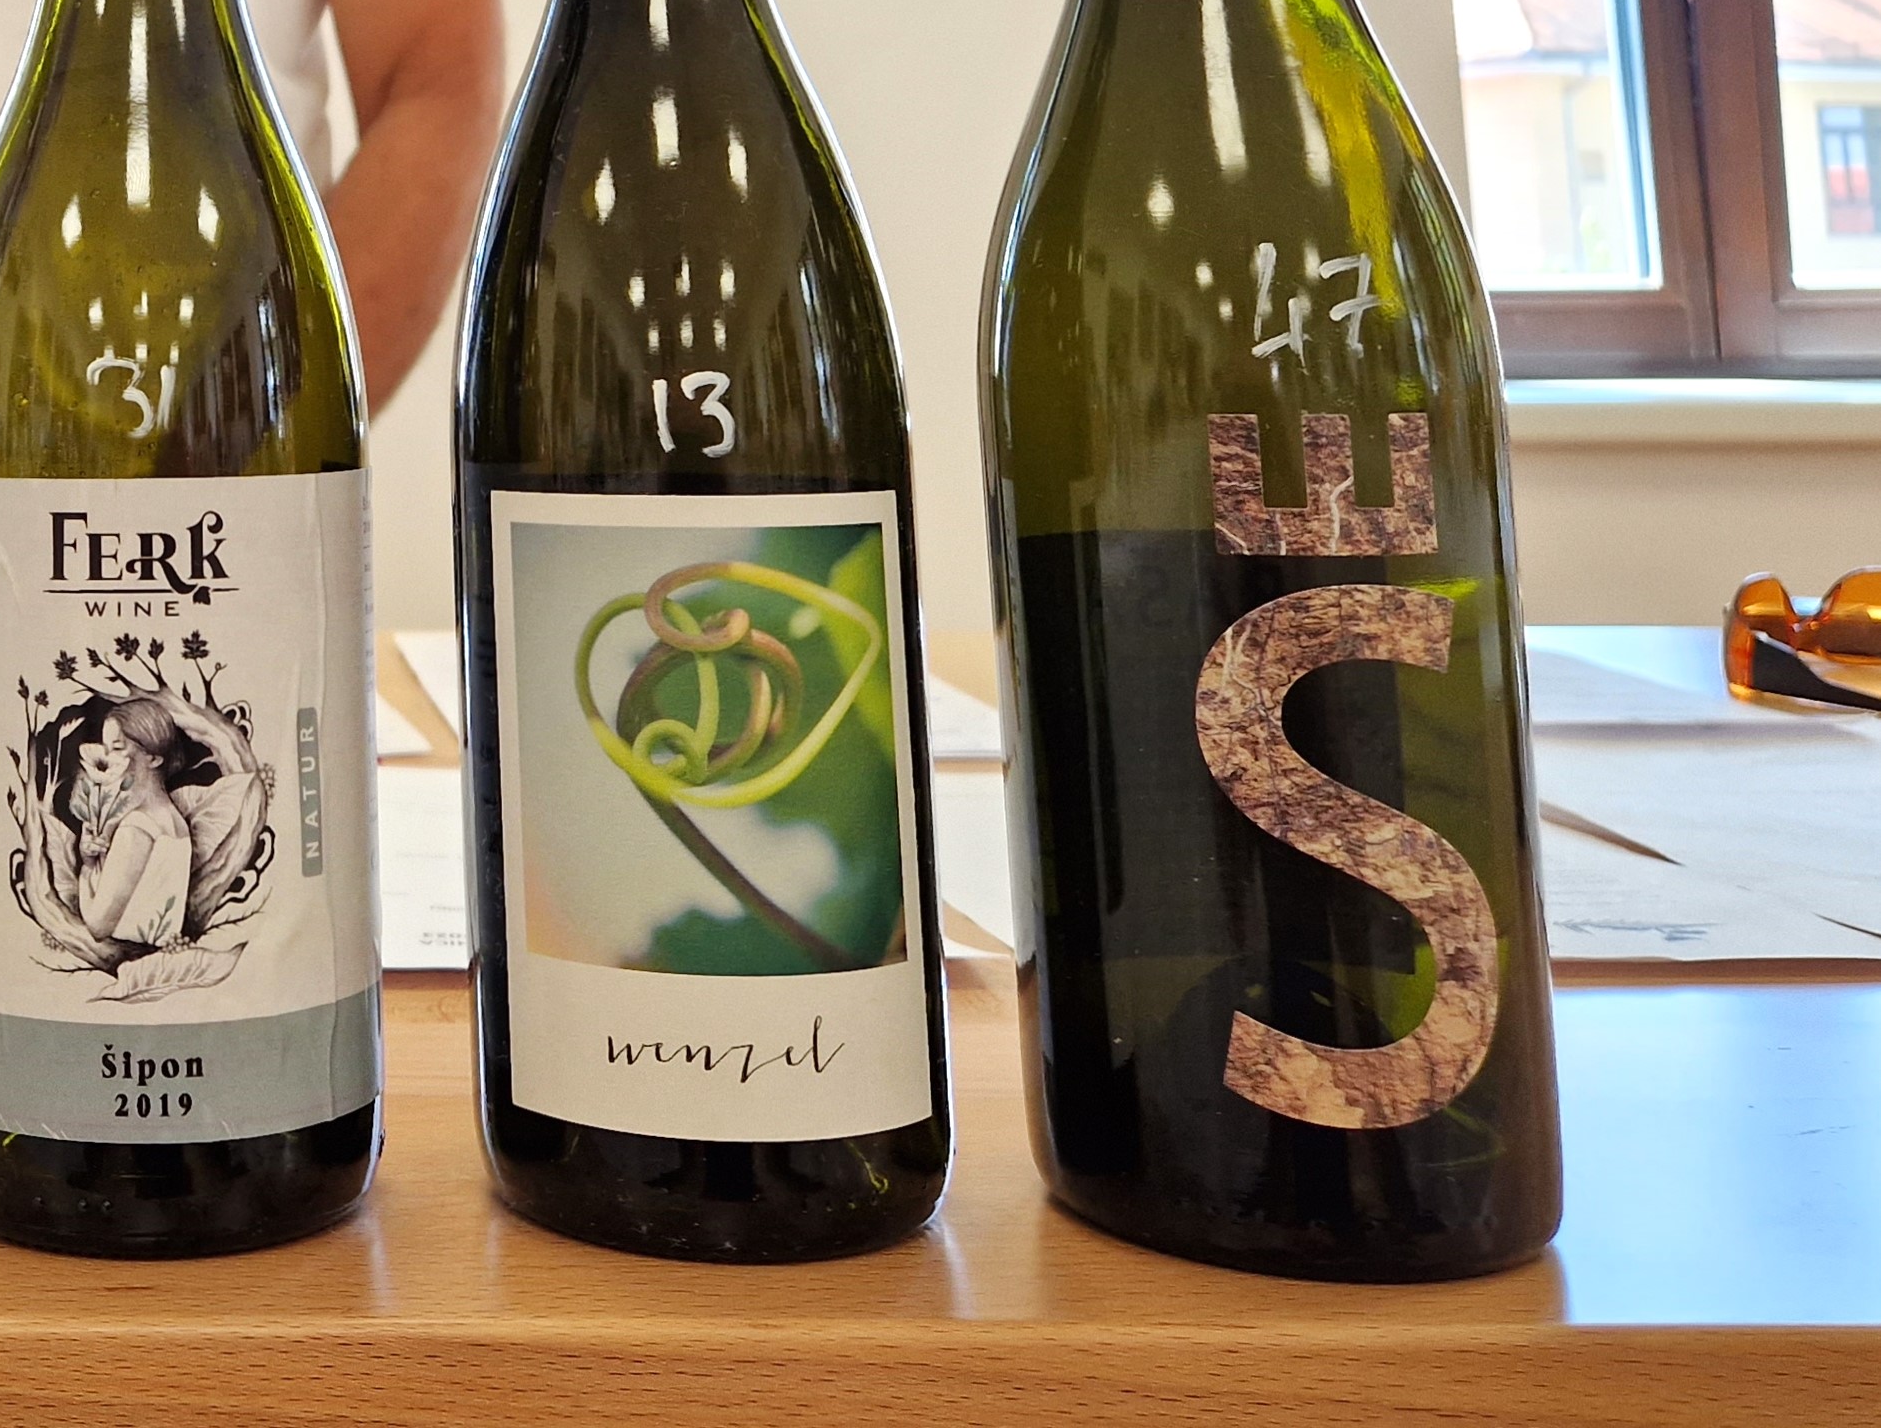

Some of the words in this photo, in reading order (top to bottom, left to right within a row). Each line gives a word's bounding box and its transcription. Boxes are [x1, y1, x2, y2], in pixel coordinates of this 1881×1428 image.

[1251, 241, 1382, 365] 47
[651, 370, 736, 458] 13
[84, 600, 180, 618] WINE
[300, 725, 321, 860] NATUR
[100, 1043, 204, 1087] Šipon
[606, 1015, 846, 1084] wenzel
[114, 1092, 194, 1118] 2019
